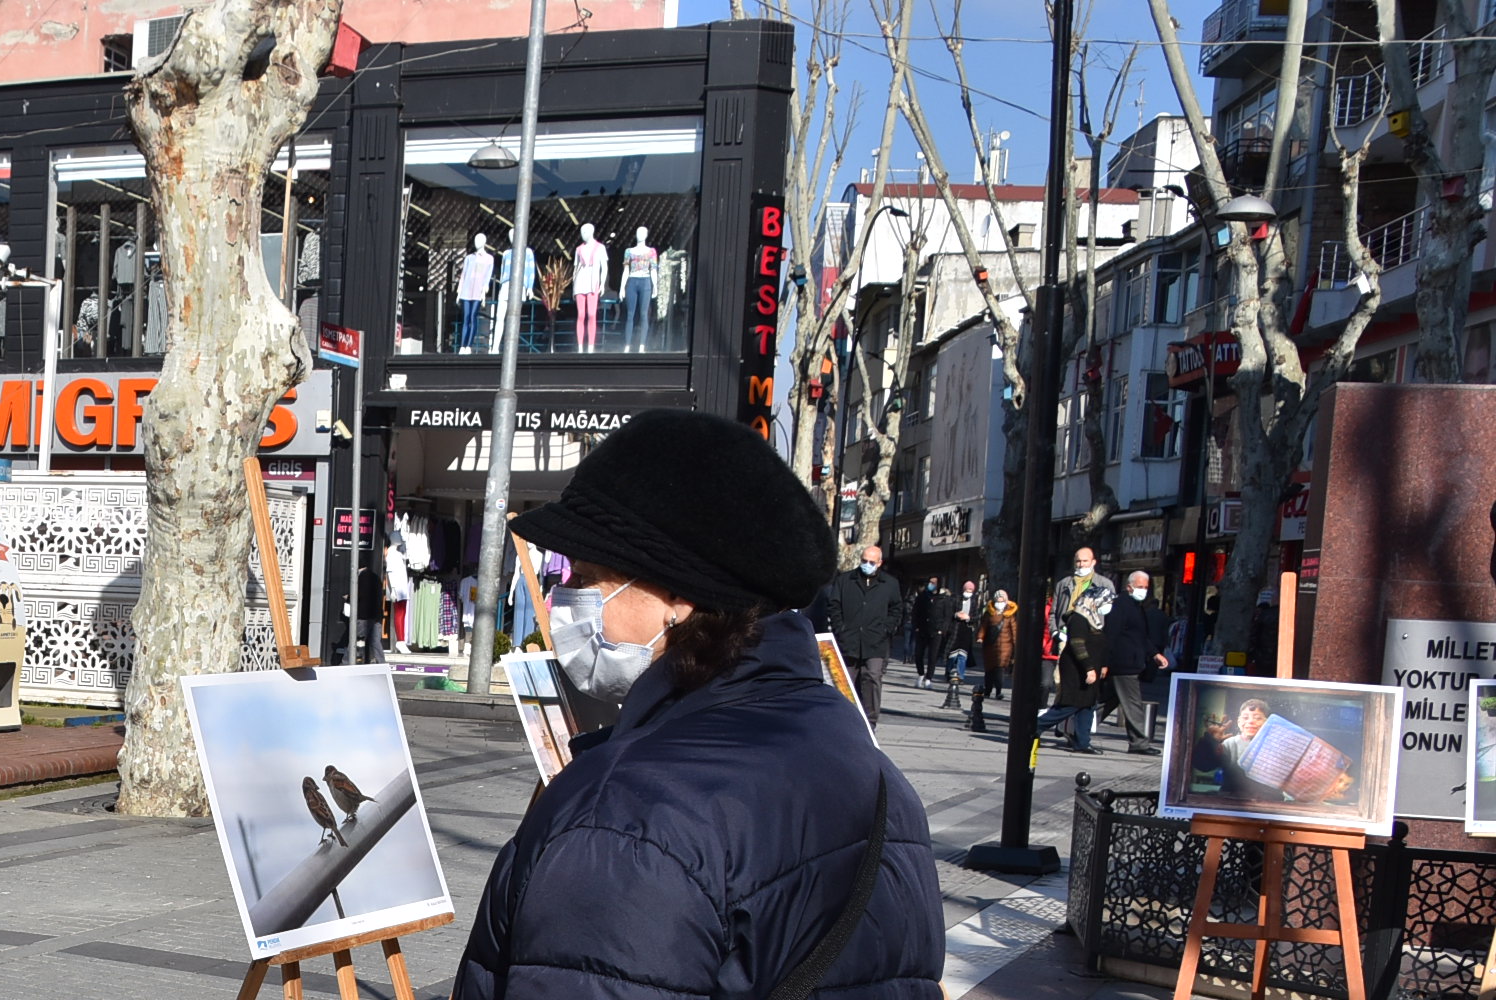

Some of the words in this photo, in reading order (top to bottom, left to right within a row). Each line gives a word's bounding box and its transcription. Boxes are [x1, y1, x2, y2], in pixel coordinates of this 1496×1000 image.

[754, 206, 782, 355] BEST
[410, 408, 482, 427] FABRİKA
[515, 412, 541, 430] TIŞ
[268, 460, 303, 478] GİRİŞ
[1405, 698, 1469, 722] MİLLE
[1401, 731, 1463, 752] ONUN
